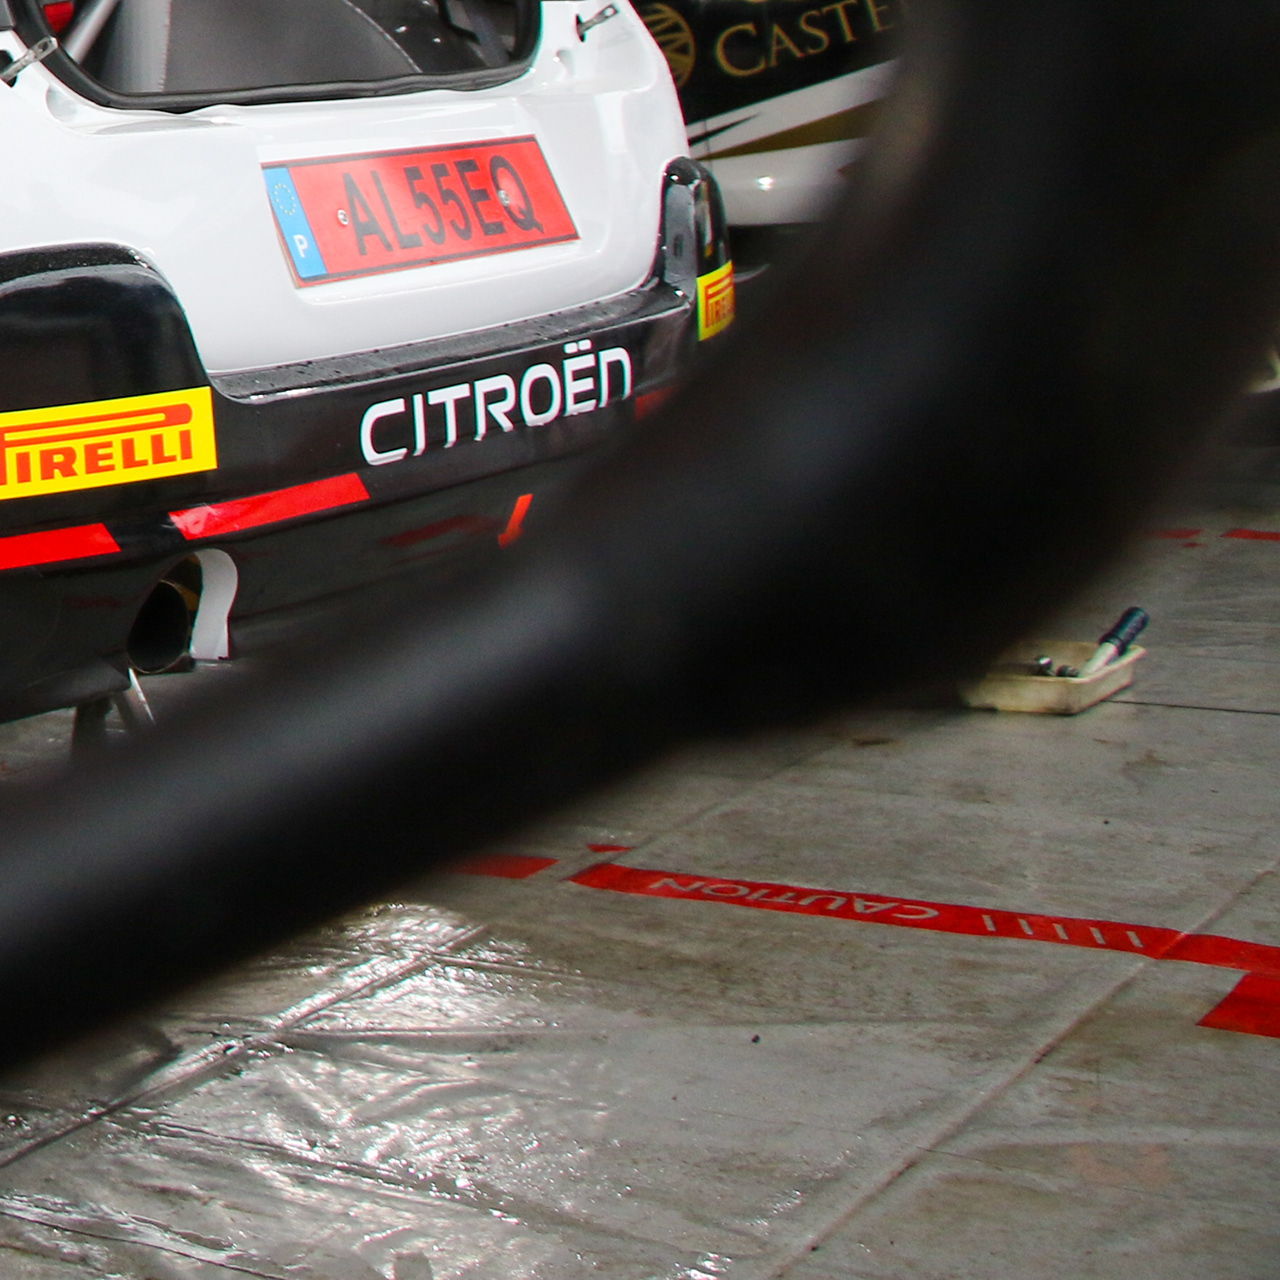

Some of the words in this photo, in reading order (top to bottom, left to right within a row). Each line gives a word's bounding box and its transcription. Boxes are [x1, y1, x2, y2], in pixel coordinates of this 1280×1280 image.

[342, 154, 545, 256] AL55EQ
[292, 233, 310, 258] P
[359, 338, 634, 467] CITROËN
[647, 876, 940, 920] CAUTION
